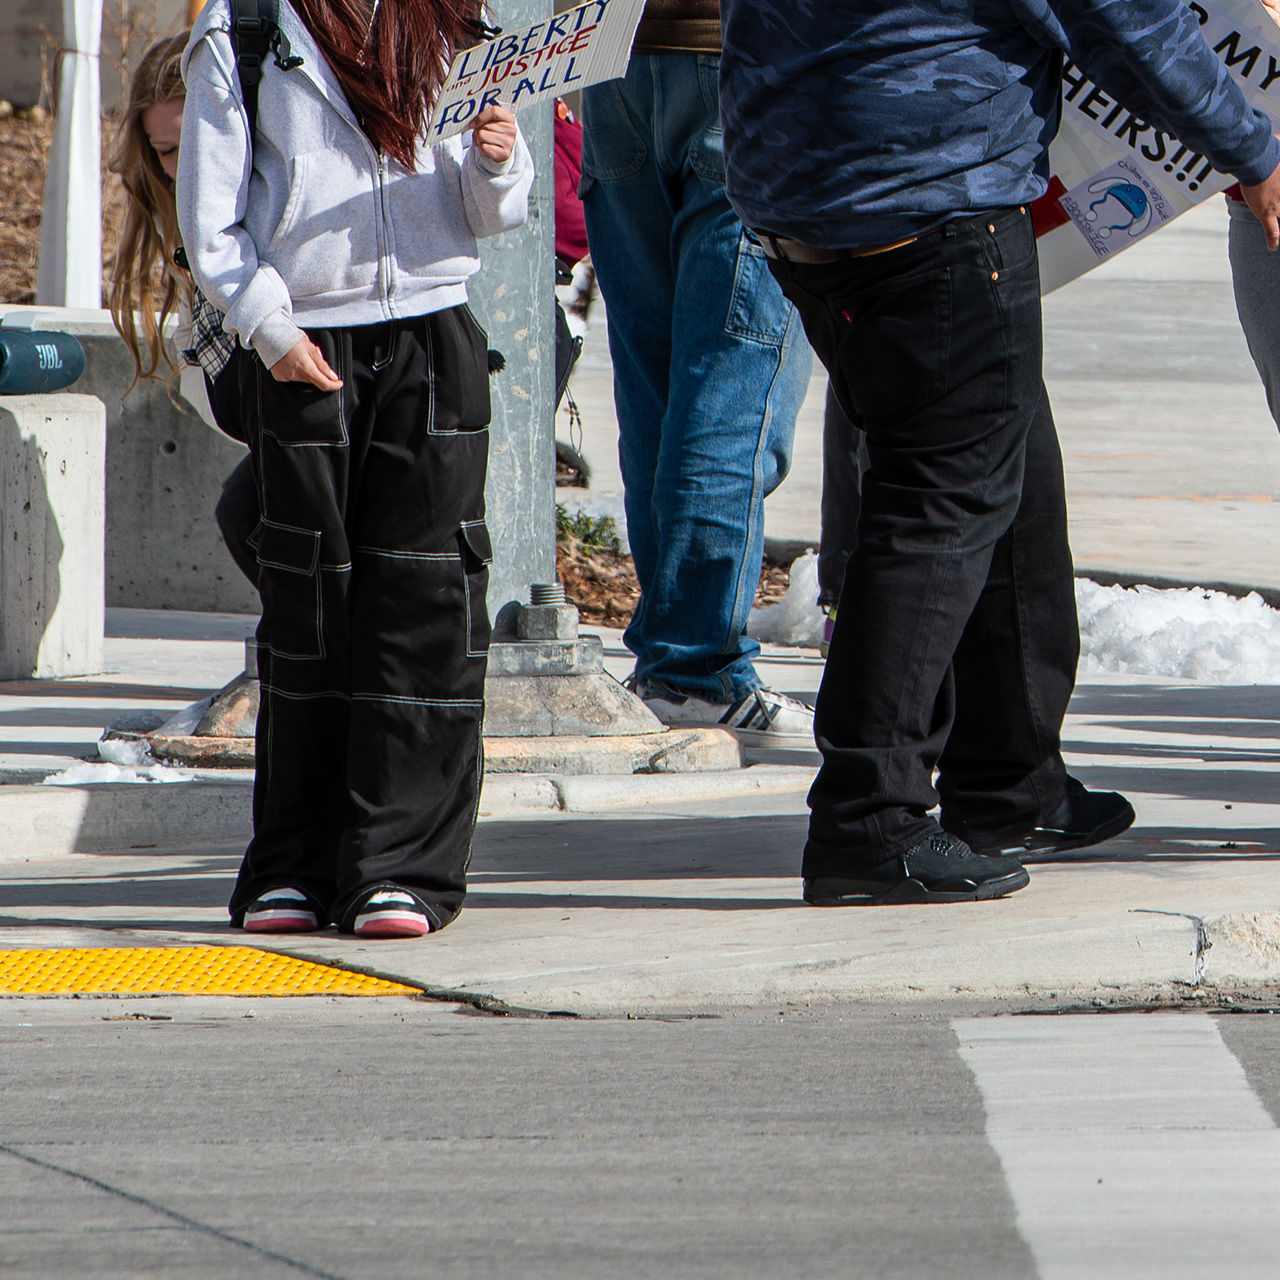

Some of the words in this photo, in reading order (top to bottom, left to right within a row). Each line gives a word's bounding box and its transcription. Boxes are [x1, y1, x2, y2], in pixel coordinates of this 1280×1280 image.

[446, 76, 472, 94] and
[466, 23, 598, 96] JUSTICE
[434, 87, 502, 136] FOR
[511, 57, 582, 105] ALL
[1149, 186, 1163, 203] NOT
[1060, 196, 1095, 235] ABOLISH
[1088, 232, 1110, 257] ICE
[39, 343, 63, 370] JBL
